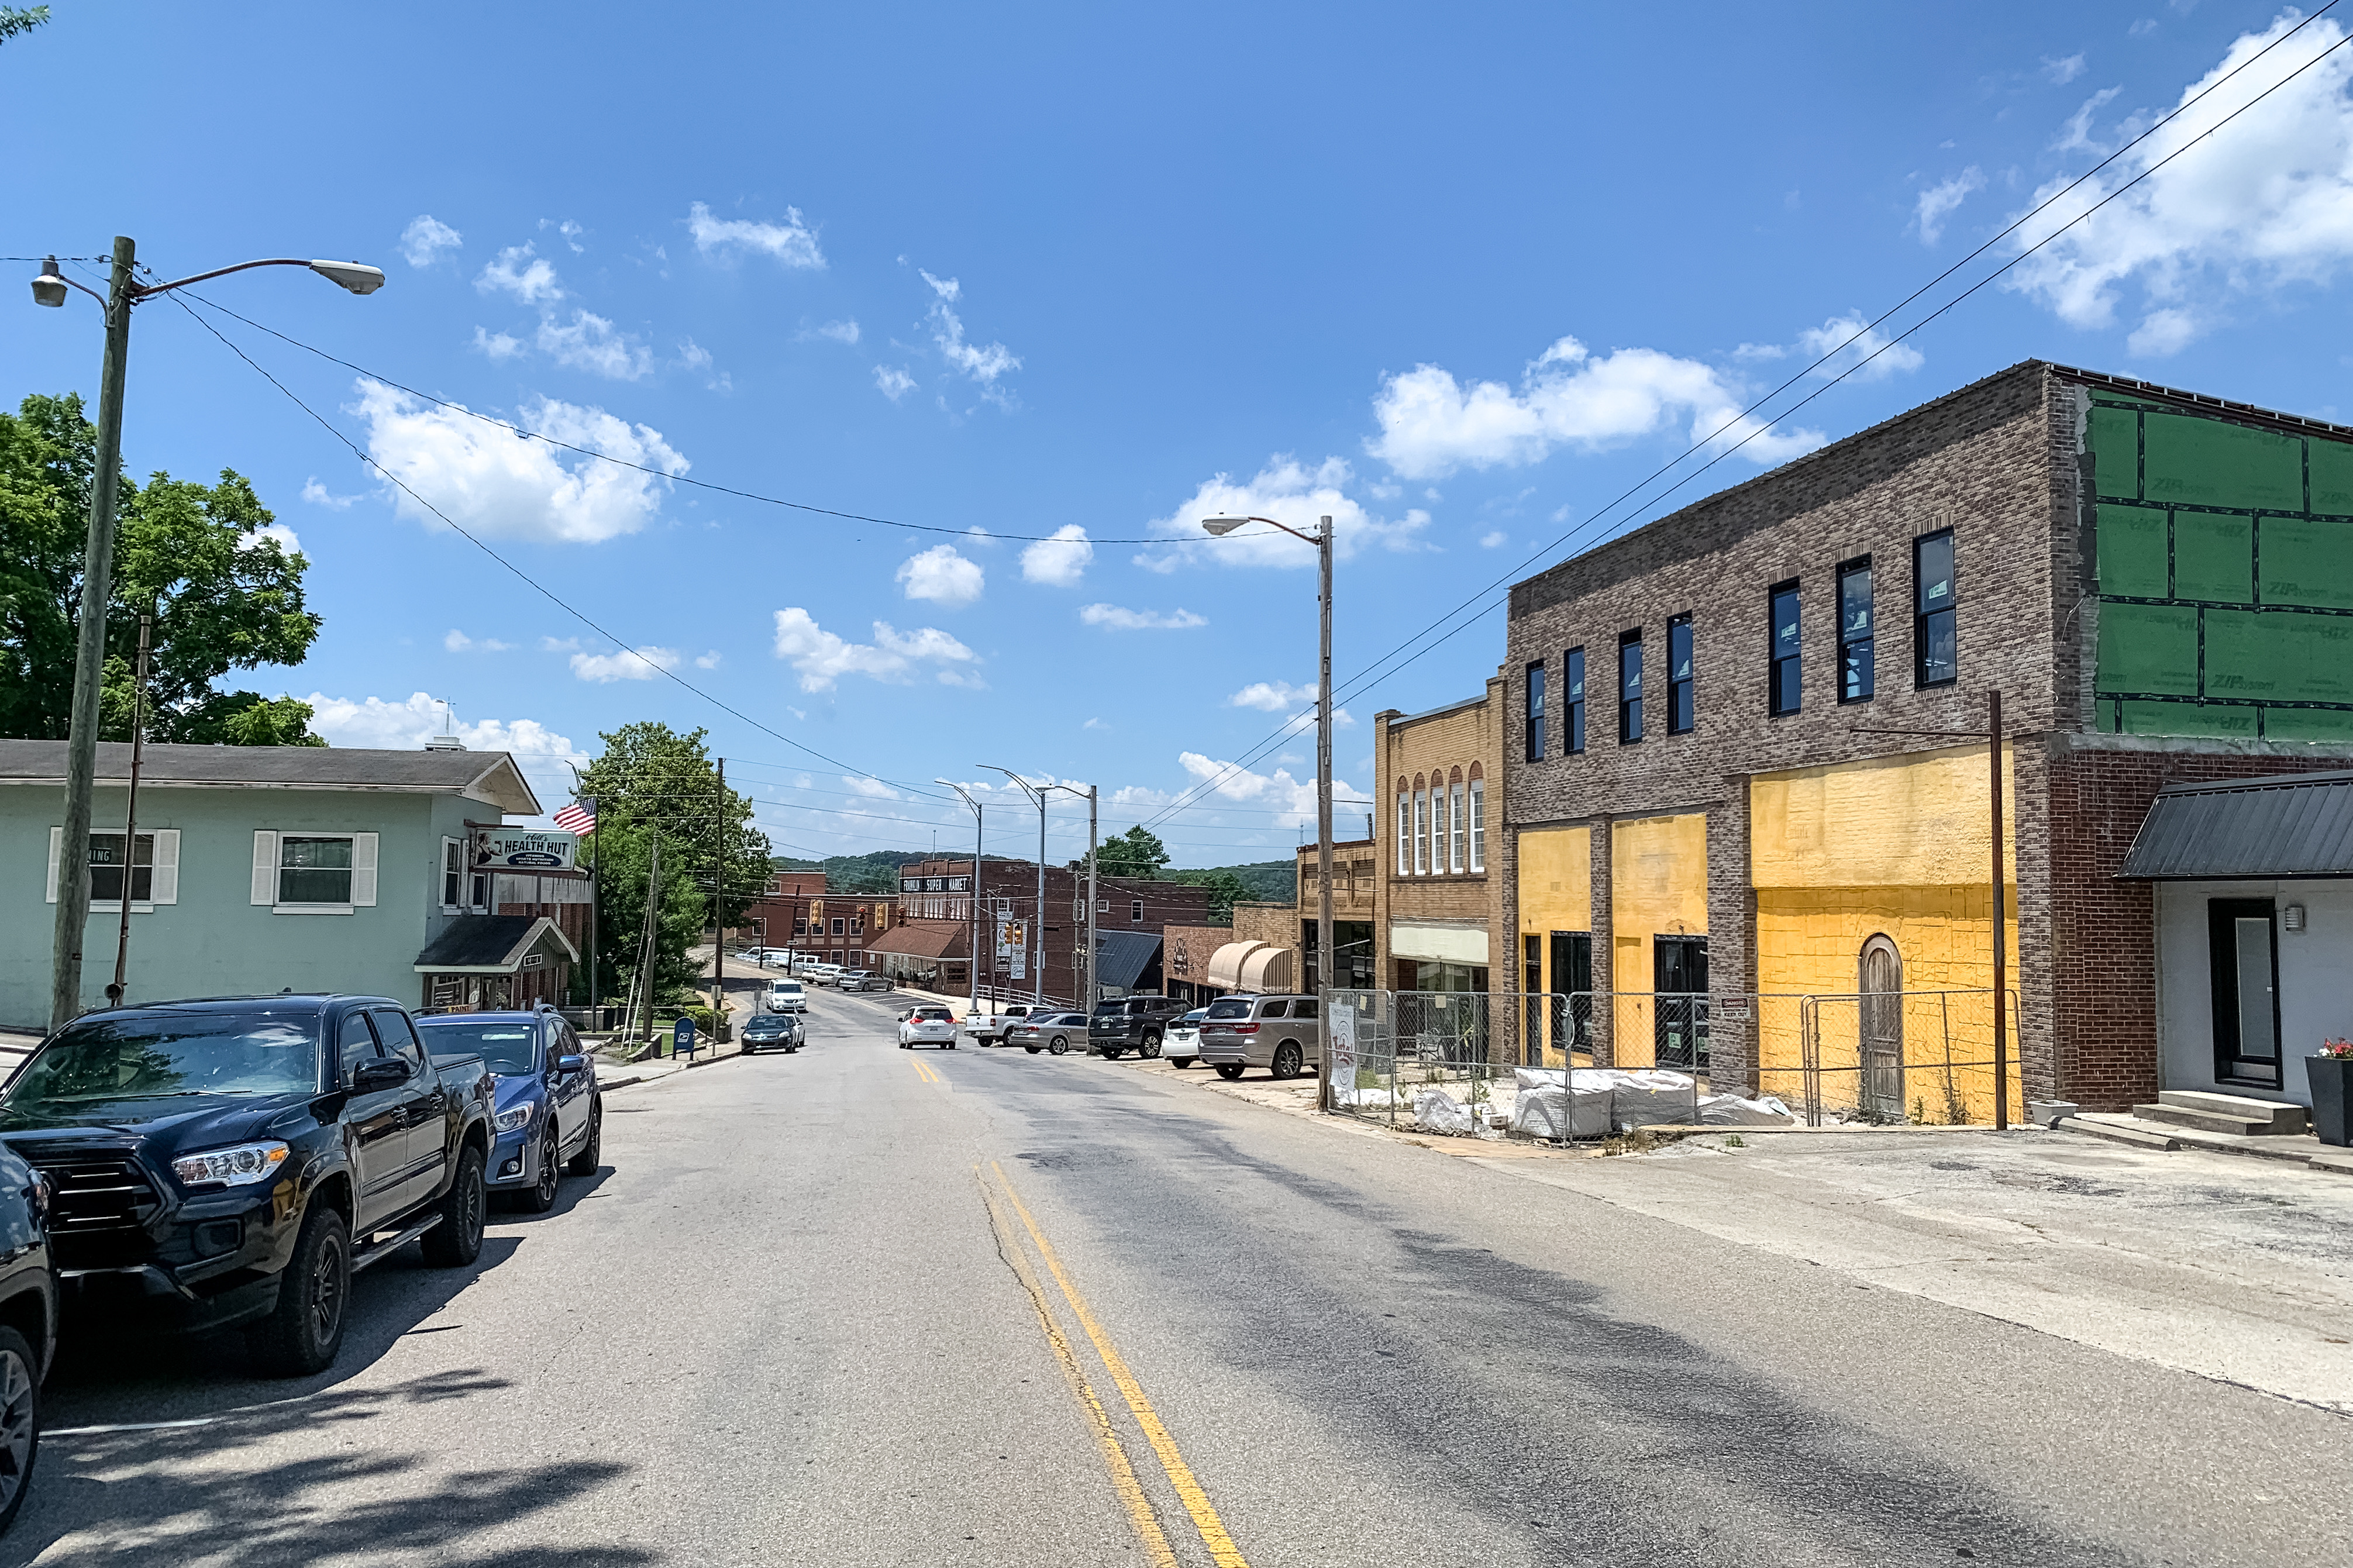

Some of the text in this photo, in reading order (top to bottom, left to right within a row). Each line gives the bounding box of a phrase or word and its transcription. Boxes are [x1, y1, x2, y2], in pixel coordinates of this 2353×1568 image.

[505, 840, 568, 856] HEALTH HUT
[926, 879, 942, 891] SUPER
[949, 878, 967, 891] MARKET
